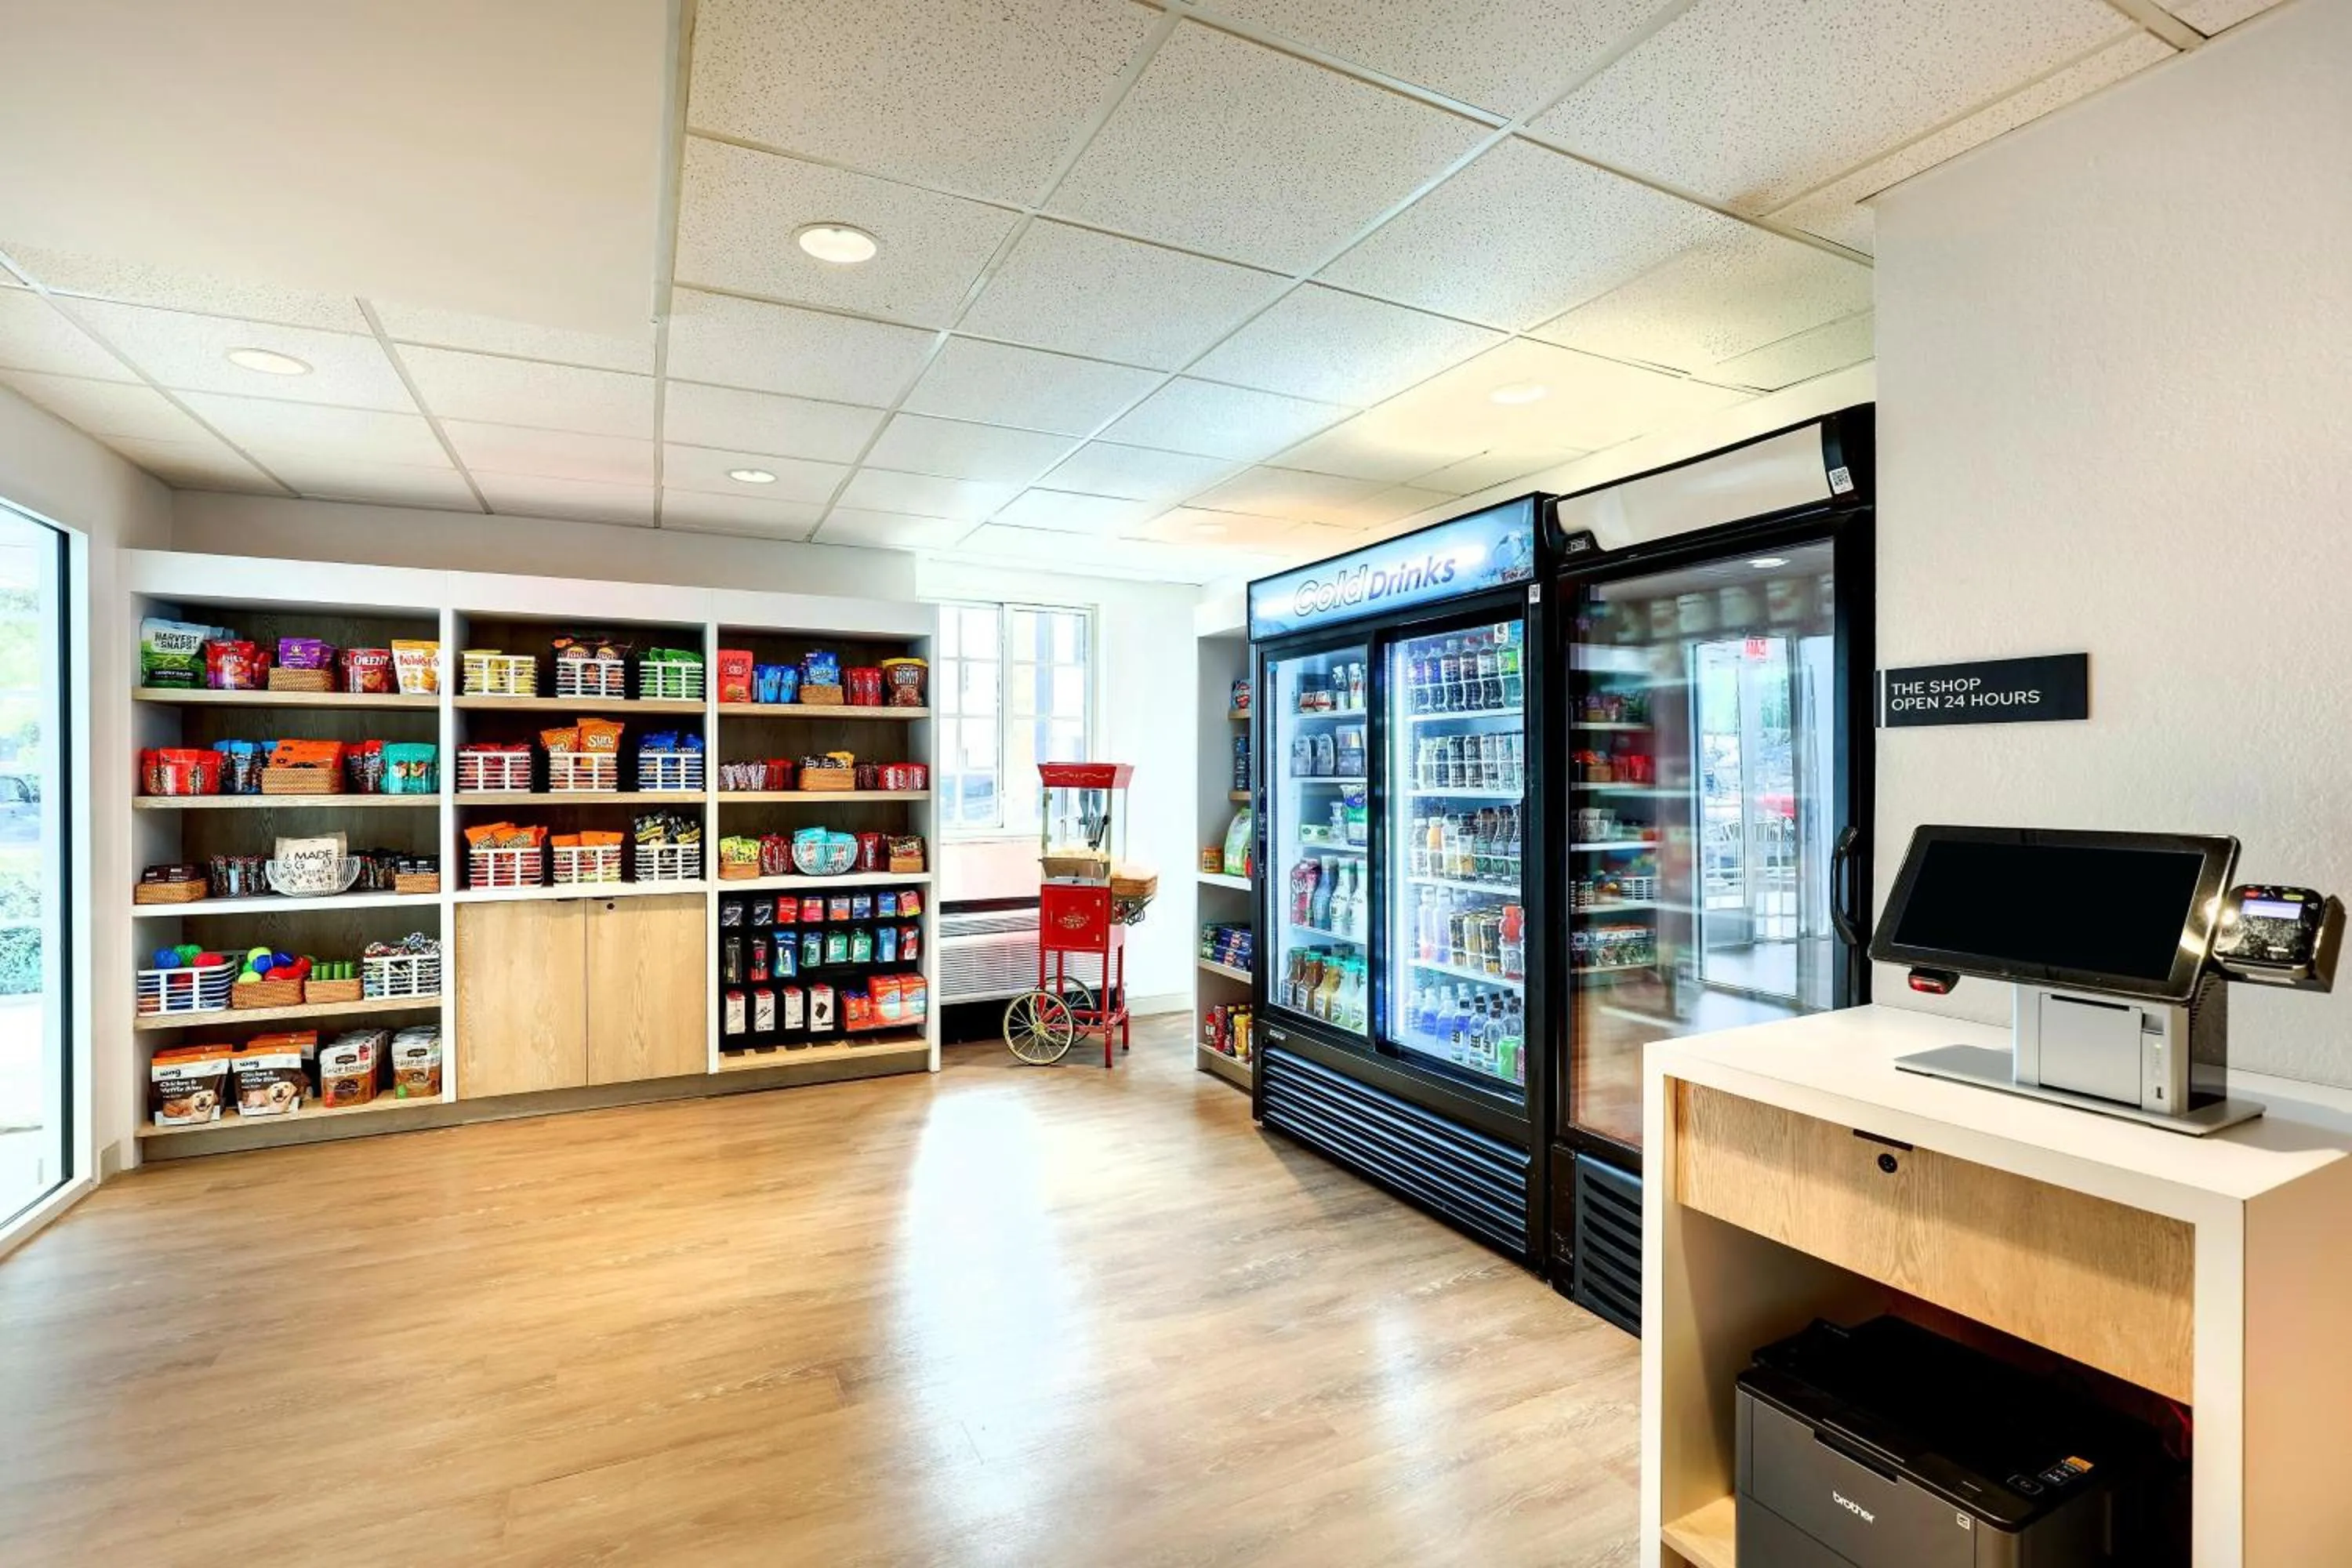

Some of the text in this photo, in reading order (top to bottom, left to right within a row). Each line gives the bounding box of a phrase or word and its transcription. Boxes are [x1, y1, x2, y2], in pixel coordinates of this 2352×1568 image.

[1293, 556, 1456, 617] Cold Drinks
[154, 631, 198, 644] HARVEST
[161, 641, 193, 650] SNAPS
[1891, 677, 1981, 696] THE SHOP
[1891, 690, 2040, 711] OPEN 24 HOURS
[294, 849, 332, 860] MADE
[1832, 1490, 1875, 1523] brother
